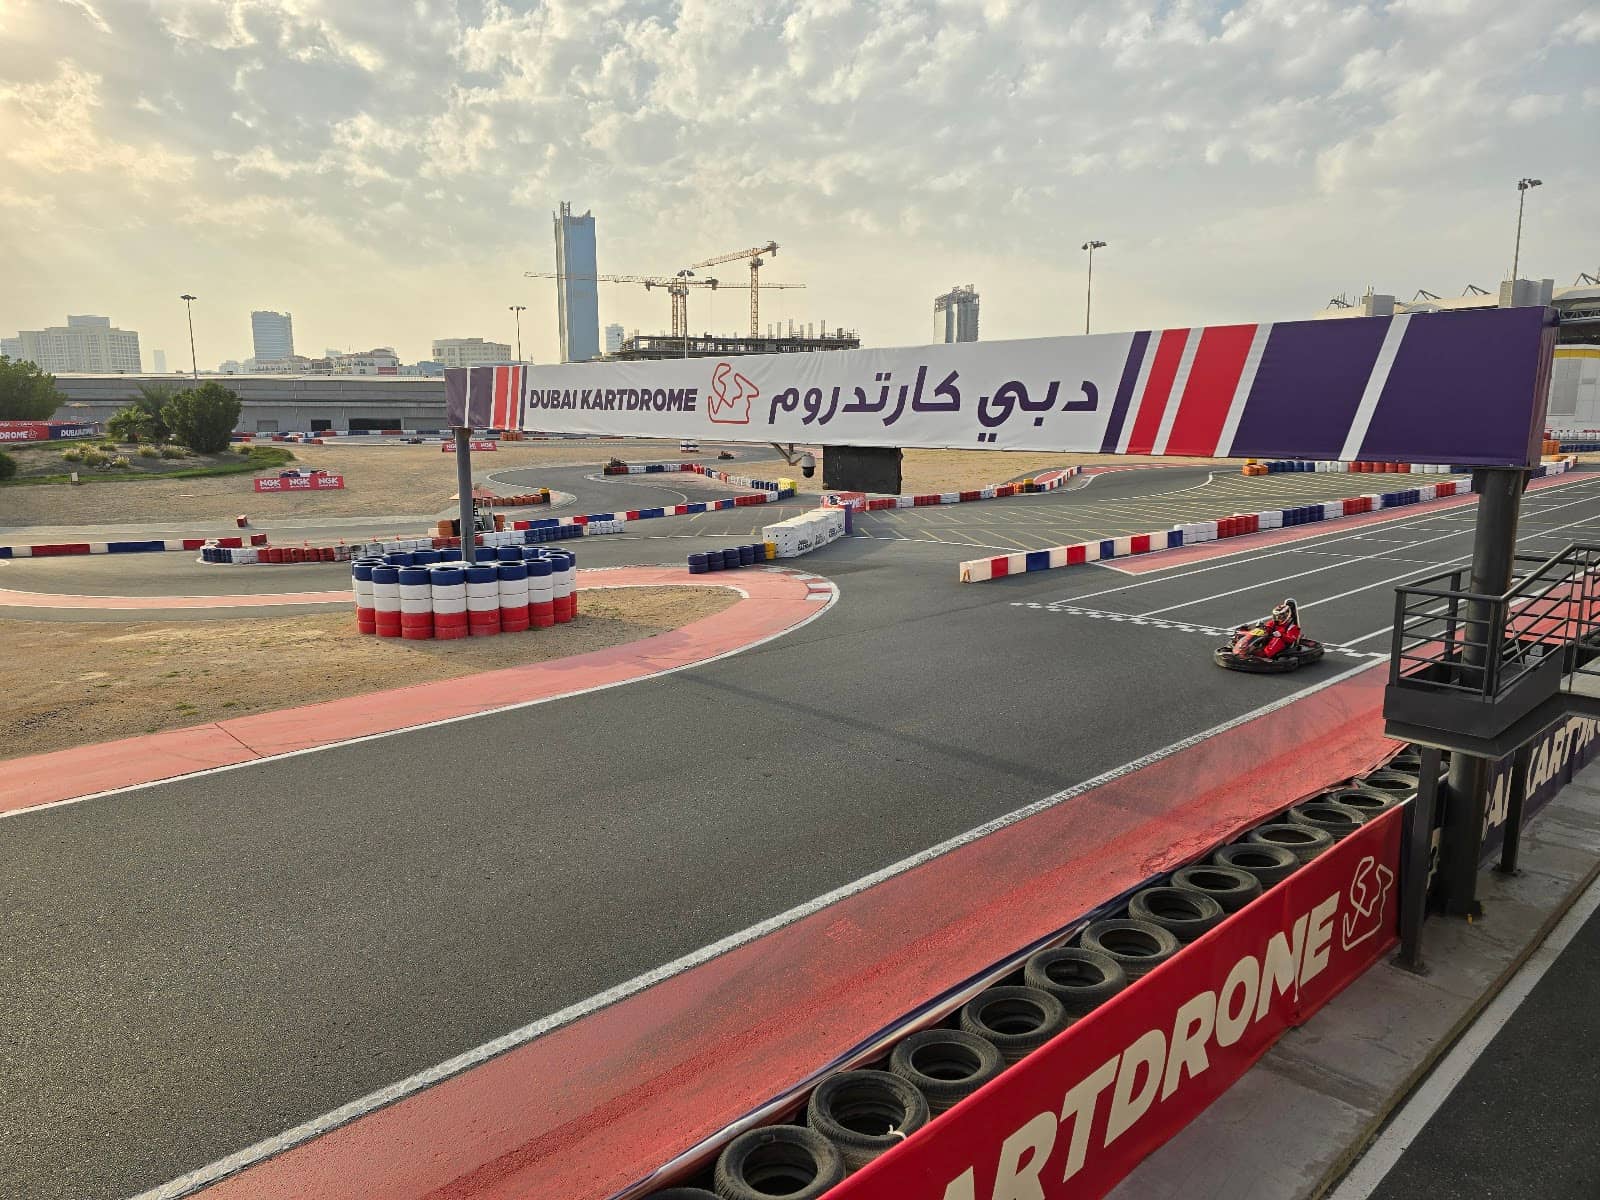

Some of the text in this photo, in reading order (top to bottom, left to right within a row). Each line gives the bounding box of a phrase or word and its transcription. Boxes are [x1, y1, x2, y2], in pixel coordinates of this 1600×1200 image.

[529, 387, 698, 412] DUBAI KARTDROME
[768, 365, 1099, 443] دبي كارتدروم
[259, 479, 281, 487] NGK
[288, 478, 310, 486] NGK
[318, 477, 338, 485] NGK
